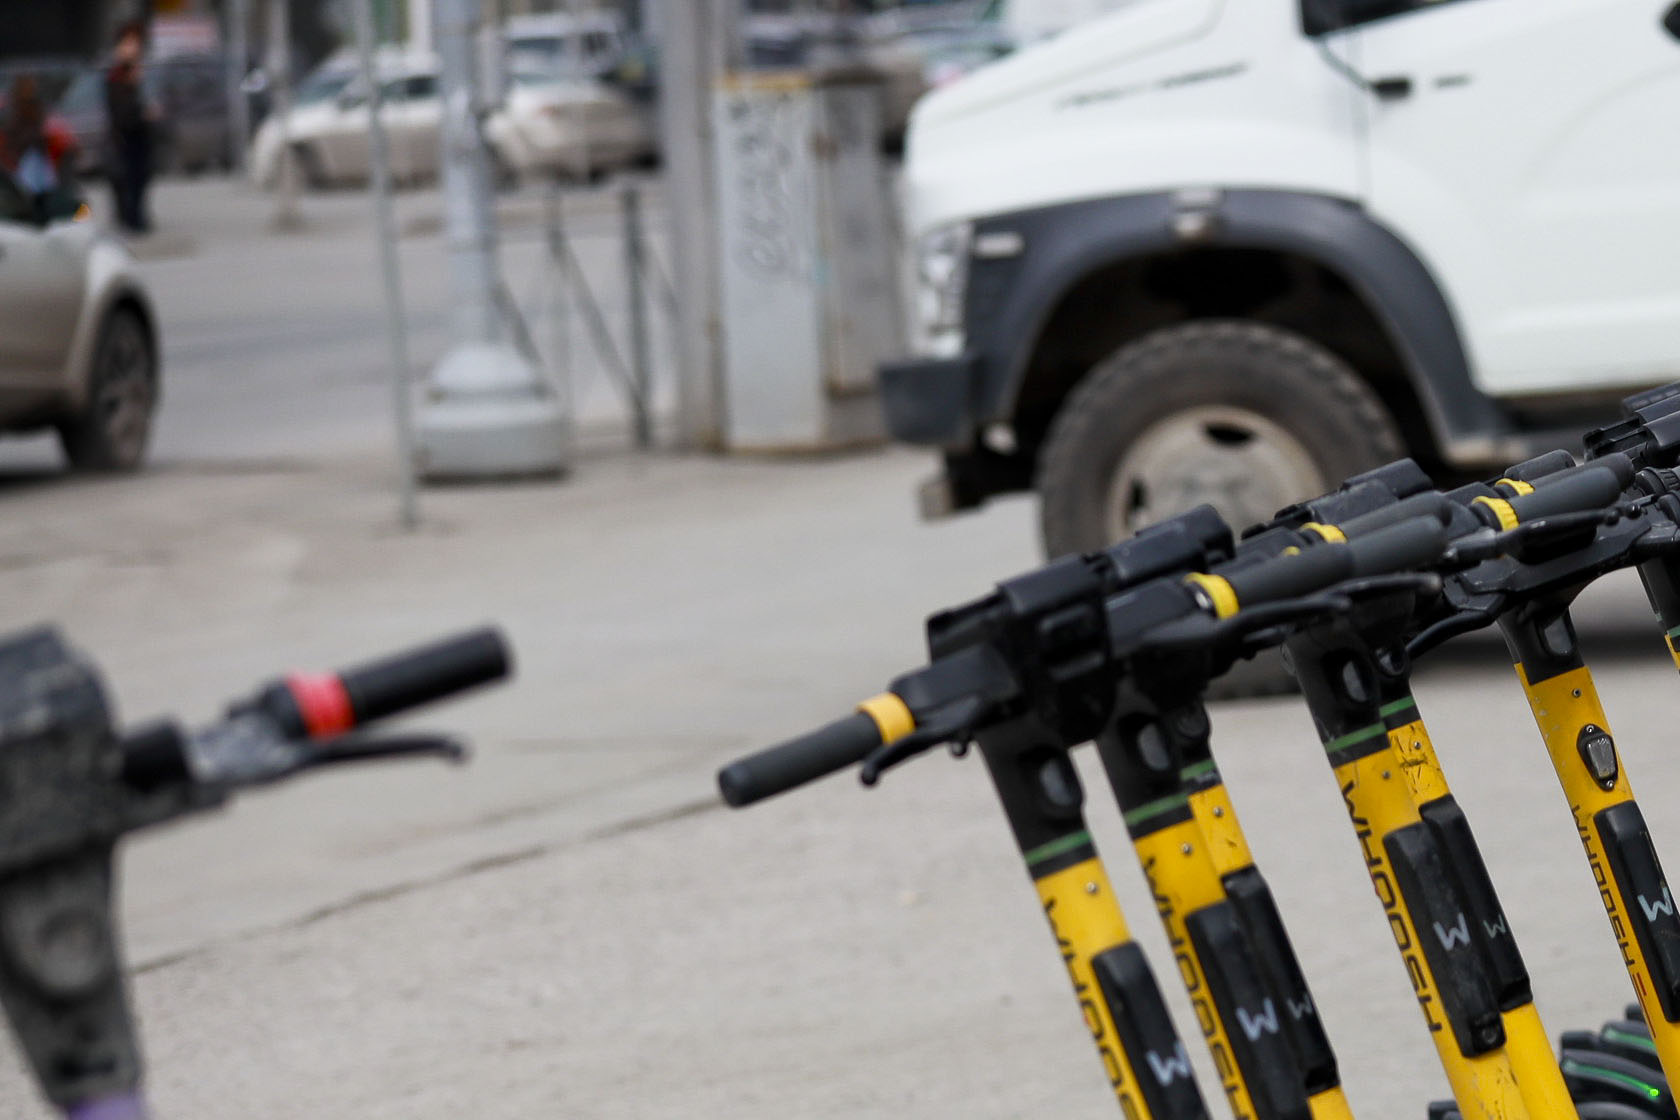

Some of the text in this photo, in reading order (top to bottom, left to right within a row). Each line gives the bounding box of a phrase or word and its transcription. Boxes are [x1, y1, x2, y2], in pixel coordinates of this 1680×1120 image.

[1341, 780, 1443, 1033] WHOOSH
[1571, 804, 1636, 966] WHOOSH
[1637, 887, 1675, 923] W
[1433, 912, 1471, 953] W
[1483, 914, 1507, 940] W
[1236, 997, 1279, 1042] W
[1146, 1038, 1192, 1088] W
